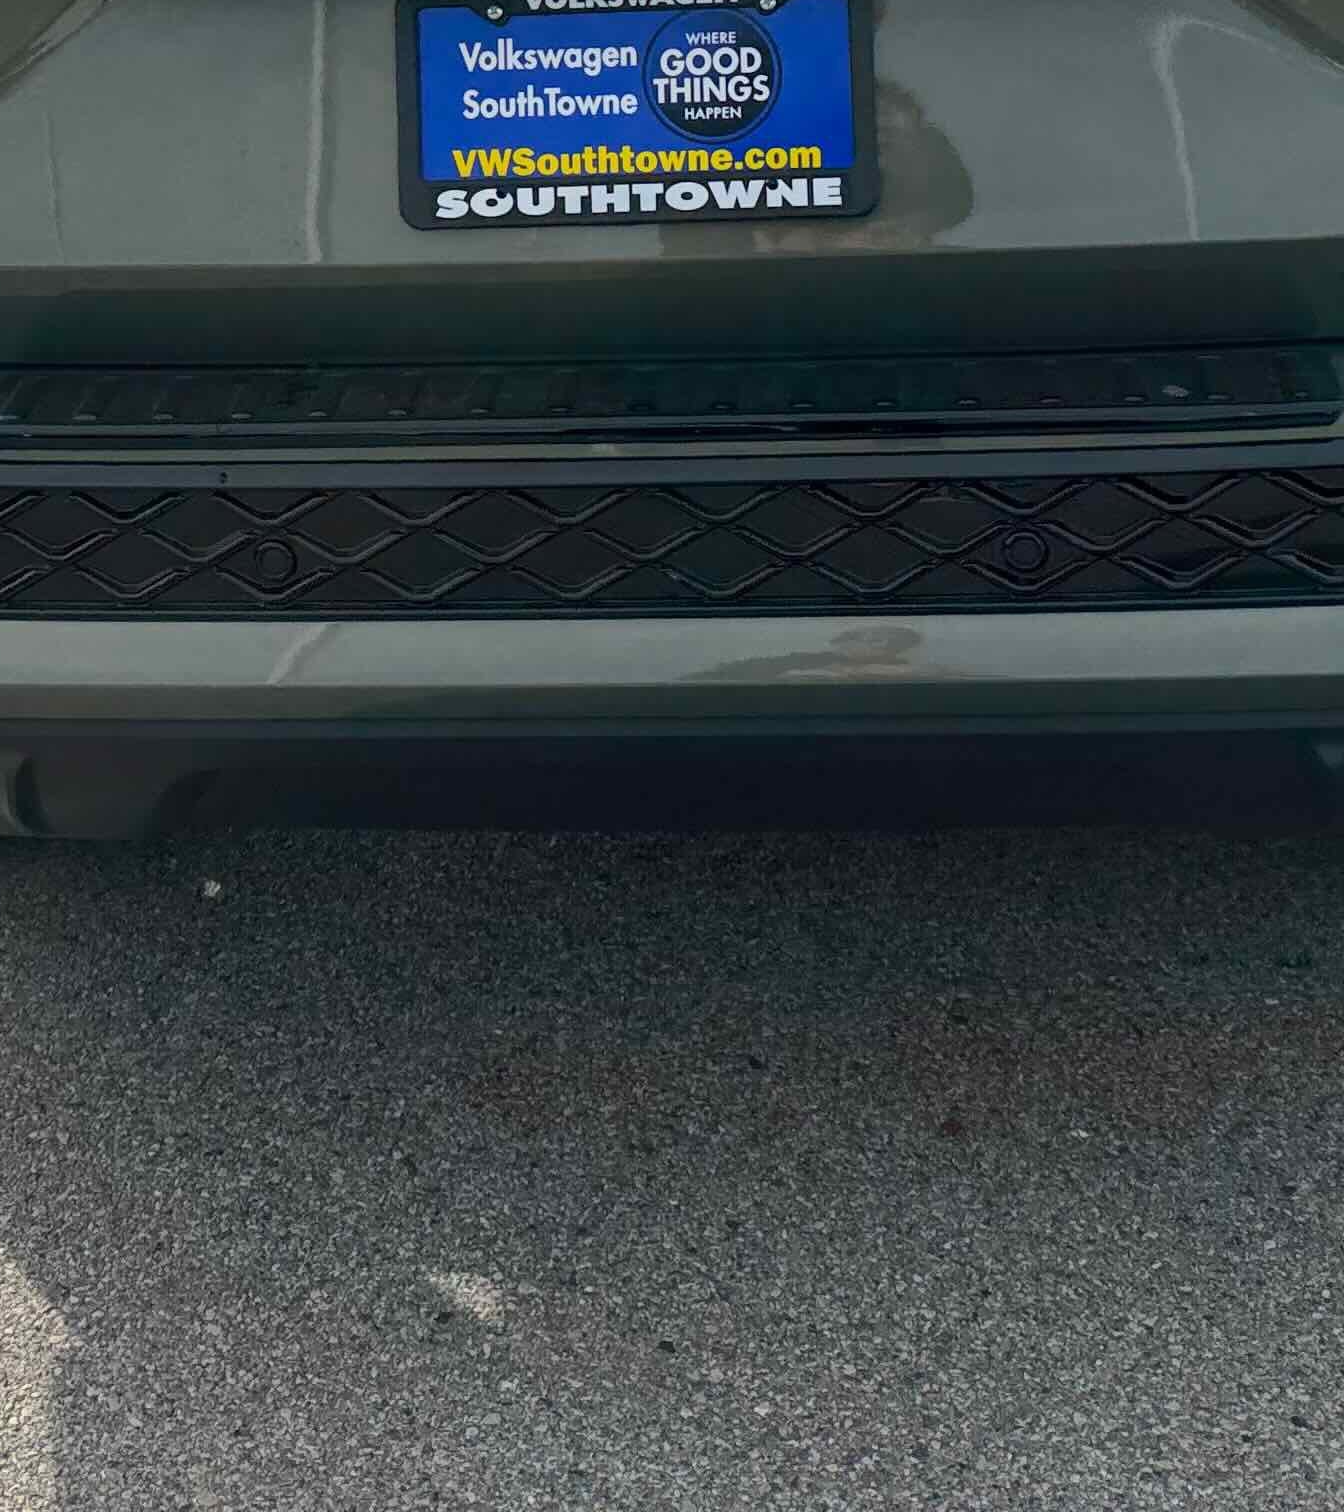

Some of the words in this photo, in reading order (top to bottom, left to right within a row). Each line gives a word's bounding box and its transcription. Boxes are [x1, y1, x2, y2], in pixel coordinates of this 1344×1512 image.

[685, 31, 737, 46] WHERE
[459, 38, 638, 76] Volkswagen
[660, 48, 762, 77] GOOD
[462, 86, 638, 120] SouthTowne
[653, 74, 770, 105] THINGS
[684, 105, 742, 120] HAPPEN
[452, 145, 822, 177] VWSouthtowne.com
[436, 177, 843, 219] SOUTHTOWNE
